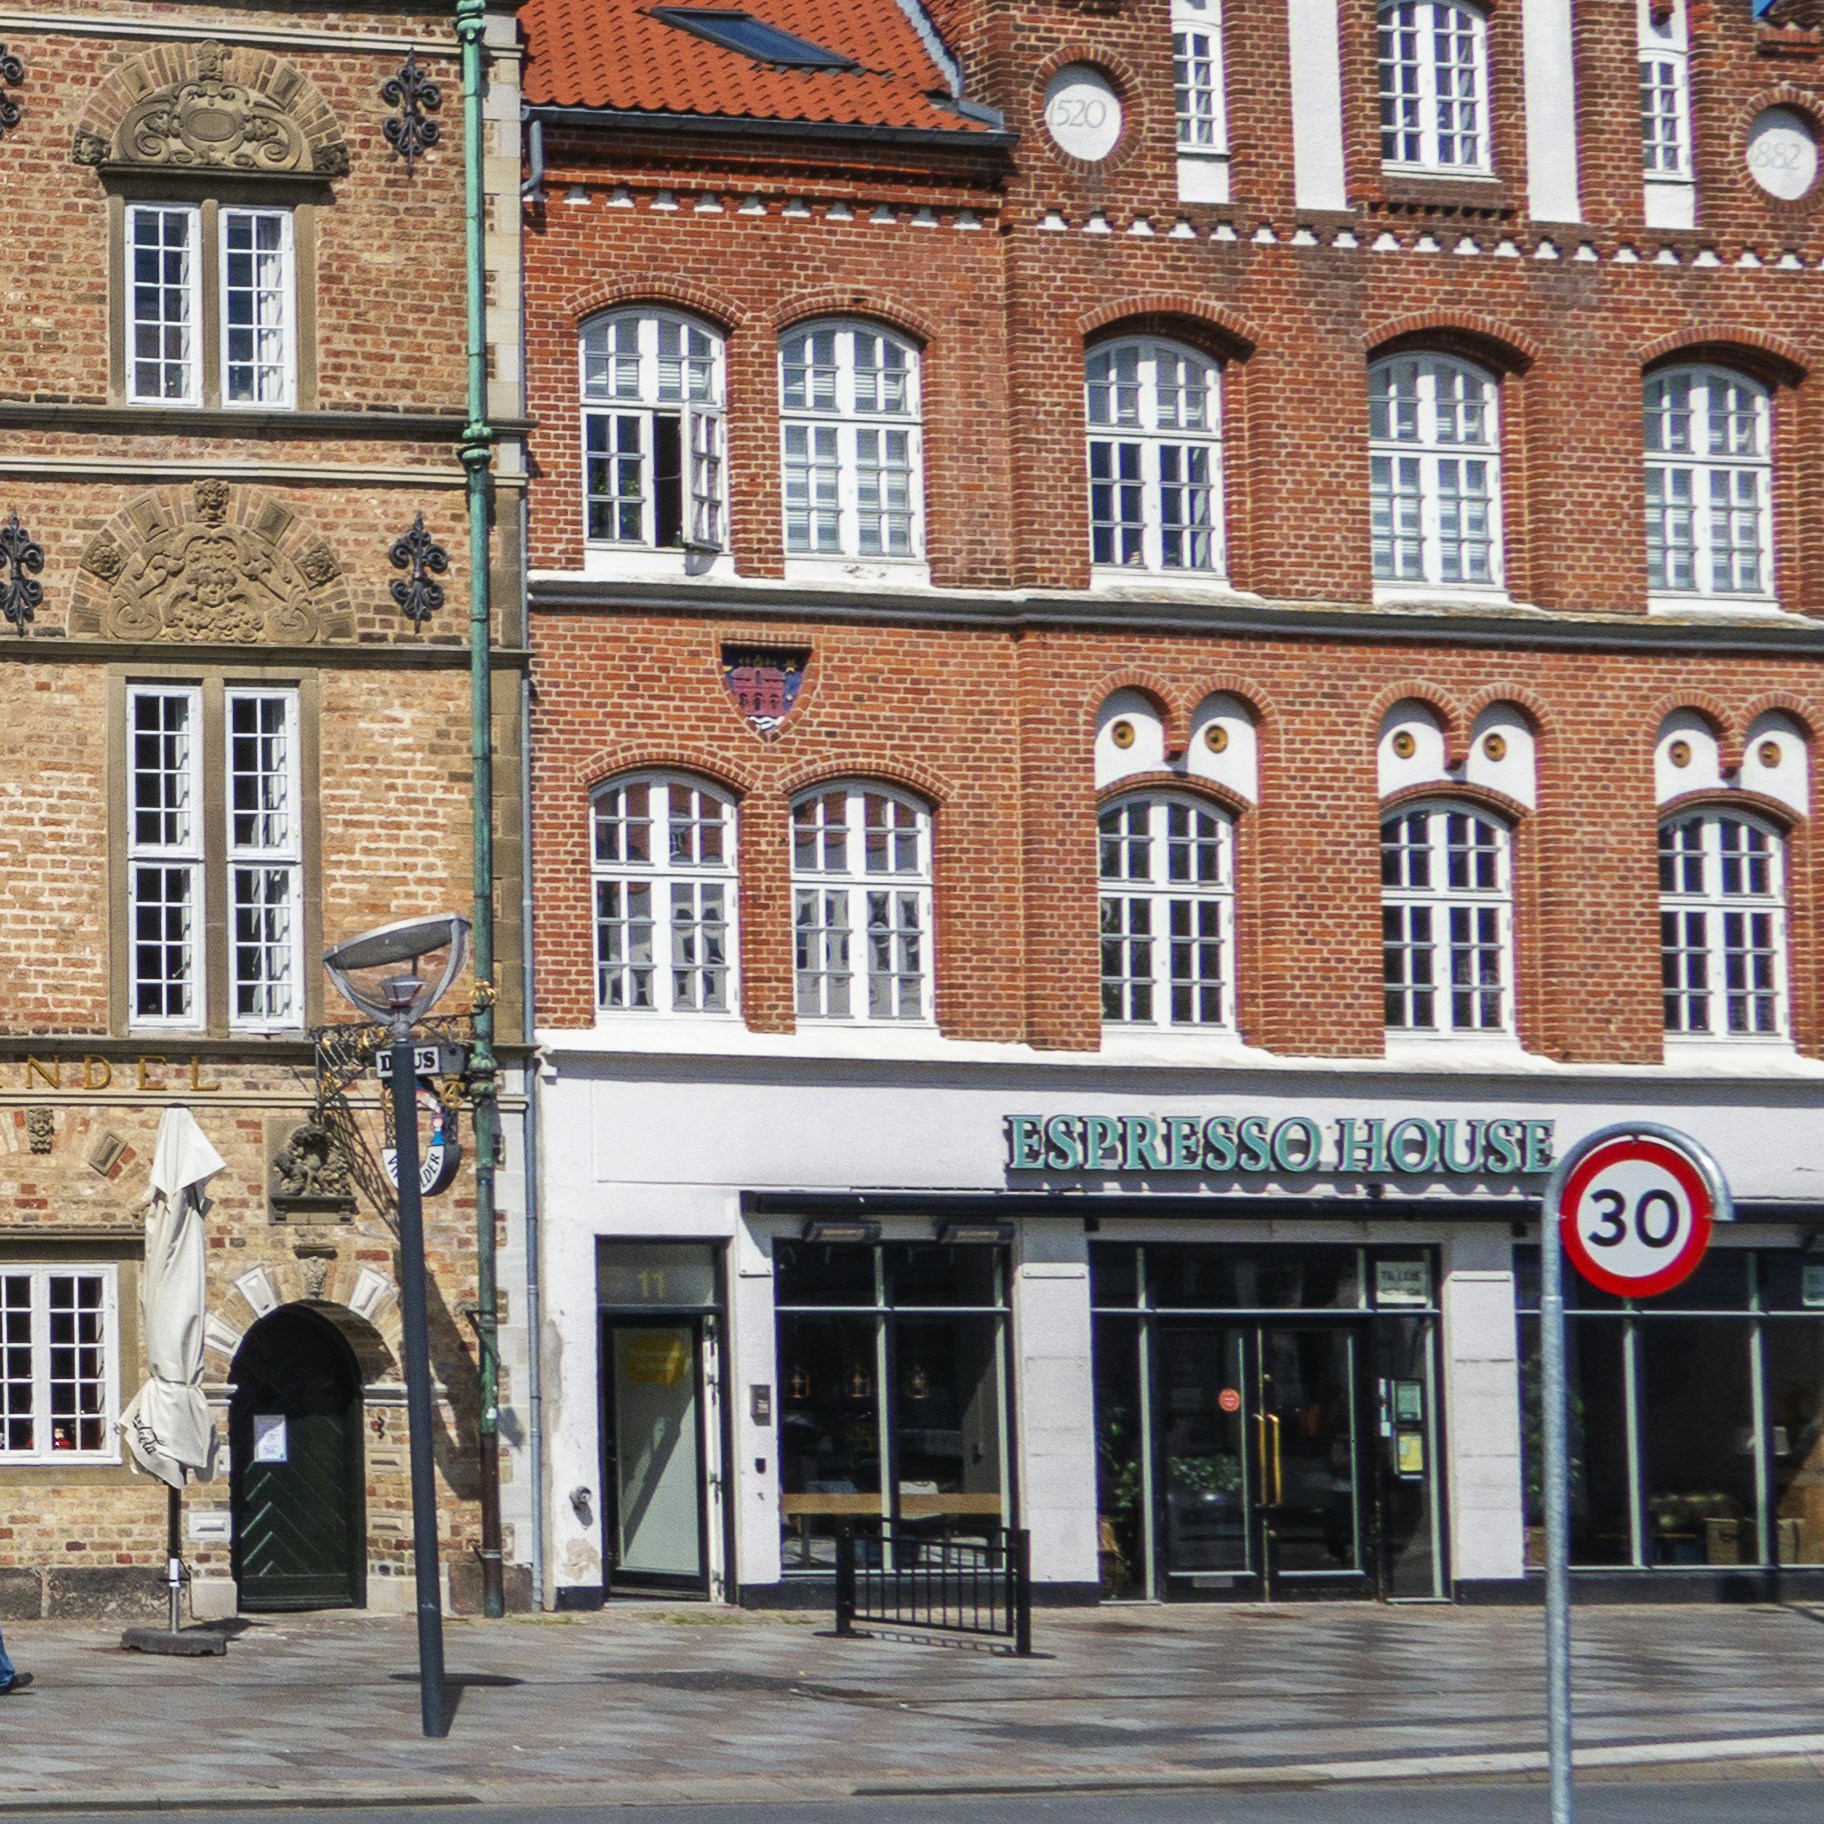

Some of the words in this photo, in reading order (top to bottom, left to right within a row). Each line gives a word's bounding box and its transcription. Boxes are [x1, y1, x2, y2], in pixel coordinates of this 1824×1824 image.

[1049, 99, 1106, 128] 1520
[1007, 1114, 1324, 1174] ESPRESSO
[1337, 1118, 1557, 1174] HOUSE
[1588, 1189, 1681, 1249] 30
[638, 1271, 666, 1298] 11
